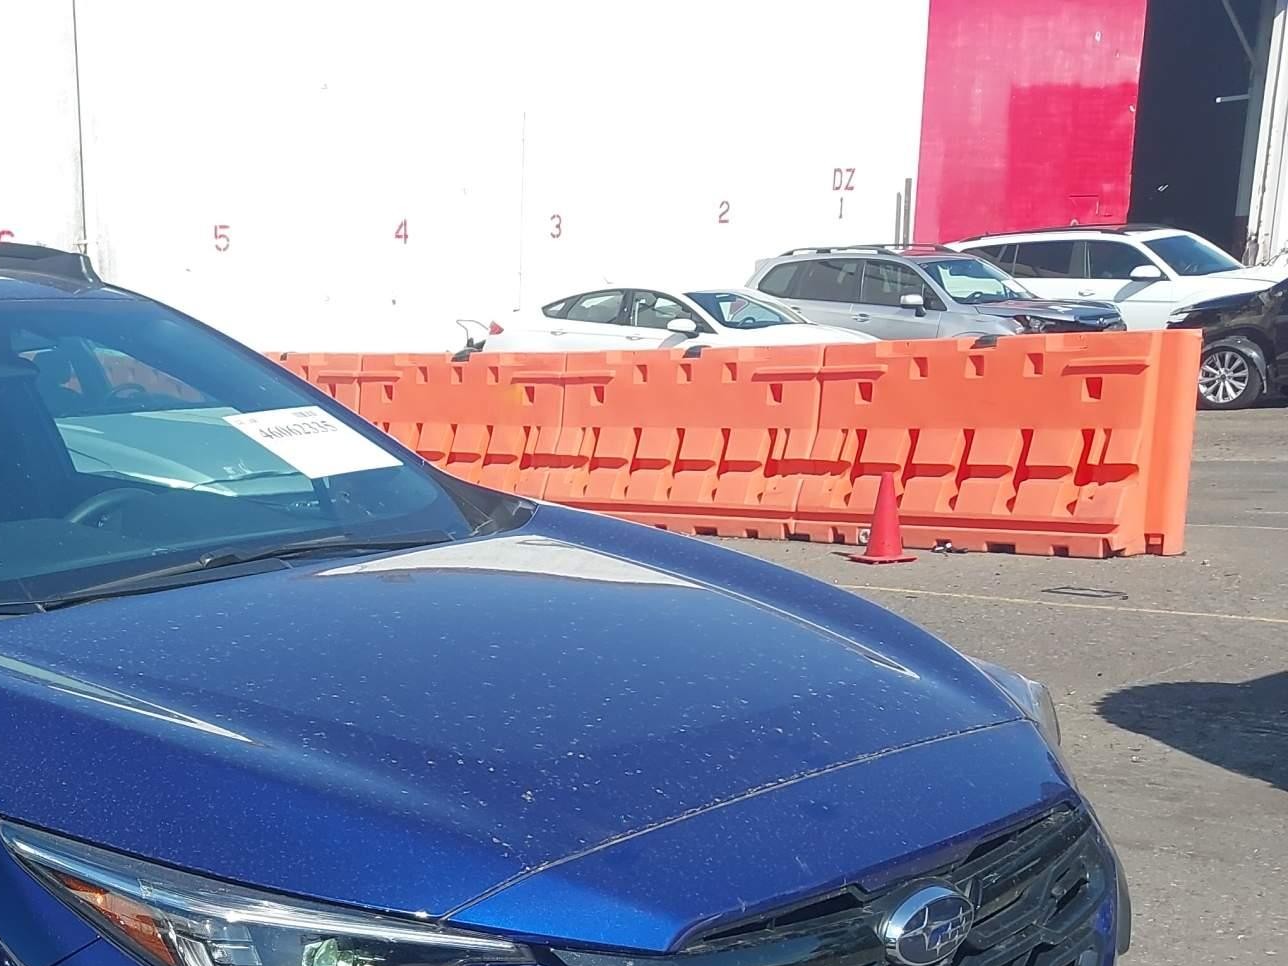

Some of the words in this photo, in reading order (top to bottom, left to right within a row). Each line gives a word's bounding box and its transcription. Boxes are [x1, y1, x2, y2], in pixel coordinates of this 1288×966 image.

[832, 167, 856, 191] DZ
[718, 200, 730, 224] 2
[214, 224, 230, 252] 5
[394, 217, 409, 245] 4
[550, 213, 562, 239] 3
